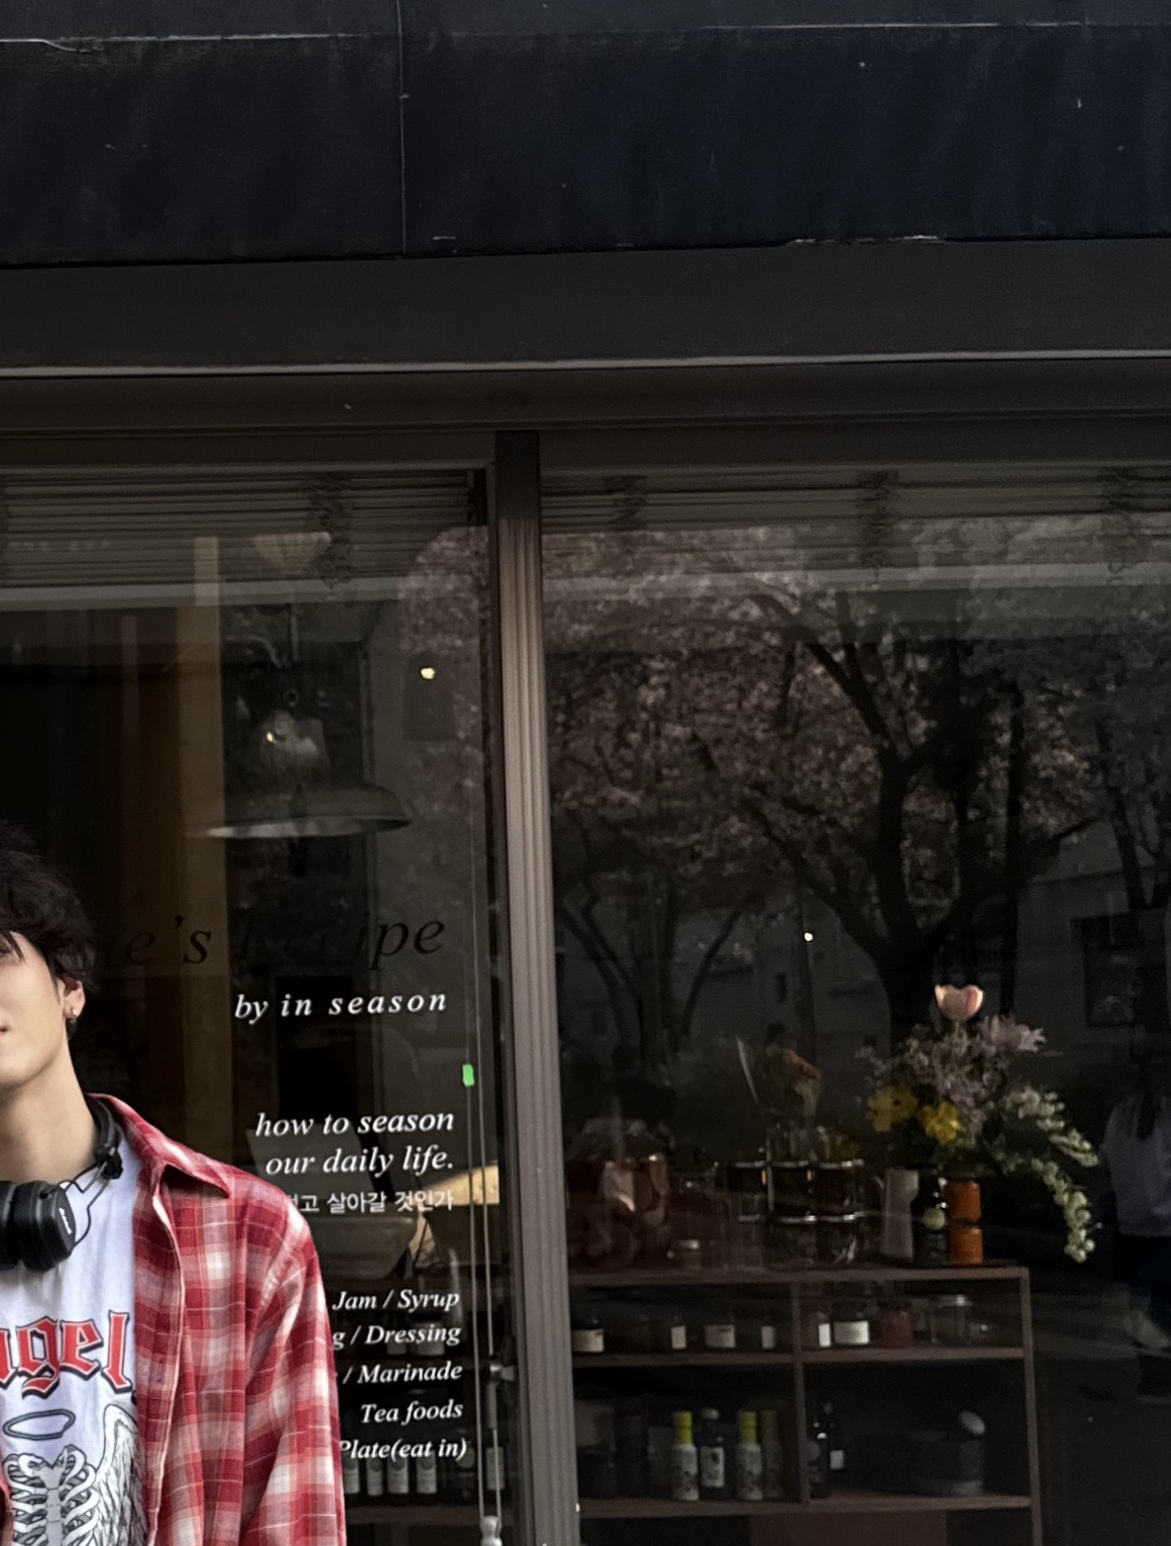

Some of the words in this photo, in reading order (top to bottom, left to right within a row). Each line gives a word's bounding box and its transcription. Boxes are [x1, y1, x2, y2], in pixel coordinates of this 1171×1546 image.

[234, 993, 269, 1025] by
[280, 993, 313, 1017] in
[328, 992, 447, 1016] season
[254, 1111, 315, 1137] how
[322, 1113, 350, 1135] to
[357, 1112, 455, 1135] season
[265, 1156, 316, 1175] our
[322, 1146, 395, 1179] daily
[402, 1144, 455, 1177] life.
[327, 1191, 387, 1215] 살아갈
[393, 1190, 455, 1213] 것인가
[331, 1290, 378, 1312] Jam
[381, 1288, 395, 1310] /
[396, 1288, 460, 1313] Syrup
[349, 1324, 362, 1346] /
[364, 1323, 463, 1347] Dressing
[341, 1365, 354, 1385] /
[356, 1360, 464, 1384] Marinade
[360, 1402, 400, 1424] Tea
[400, 1398, 465, 1427] foods
[437, 1436, 467, 1462] in)
